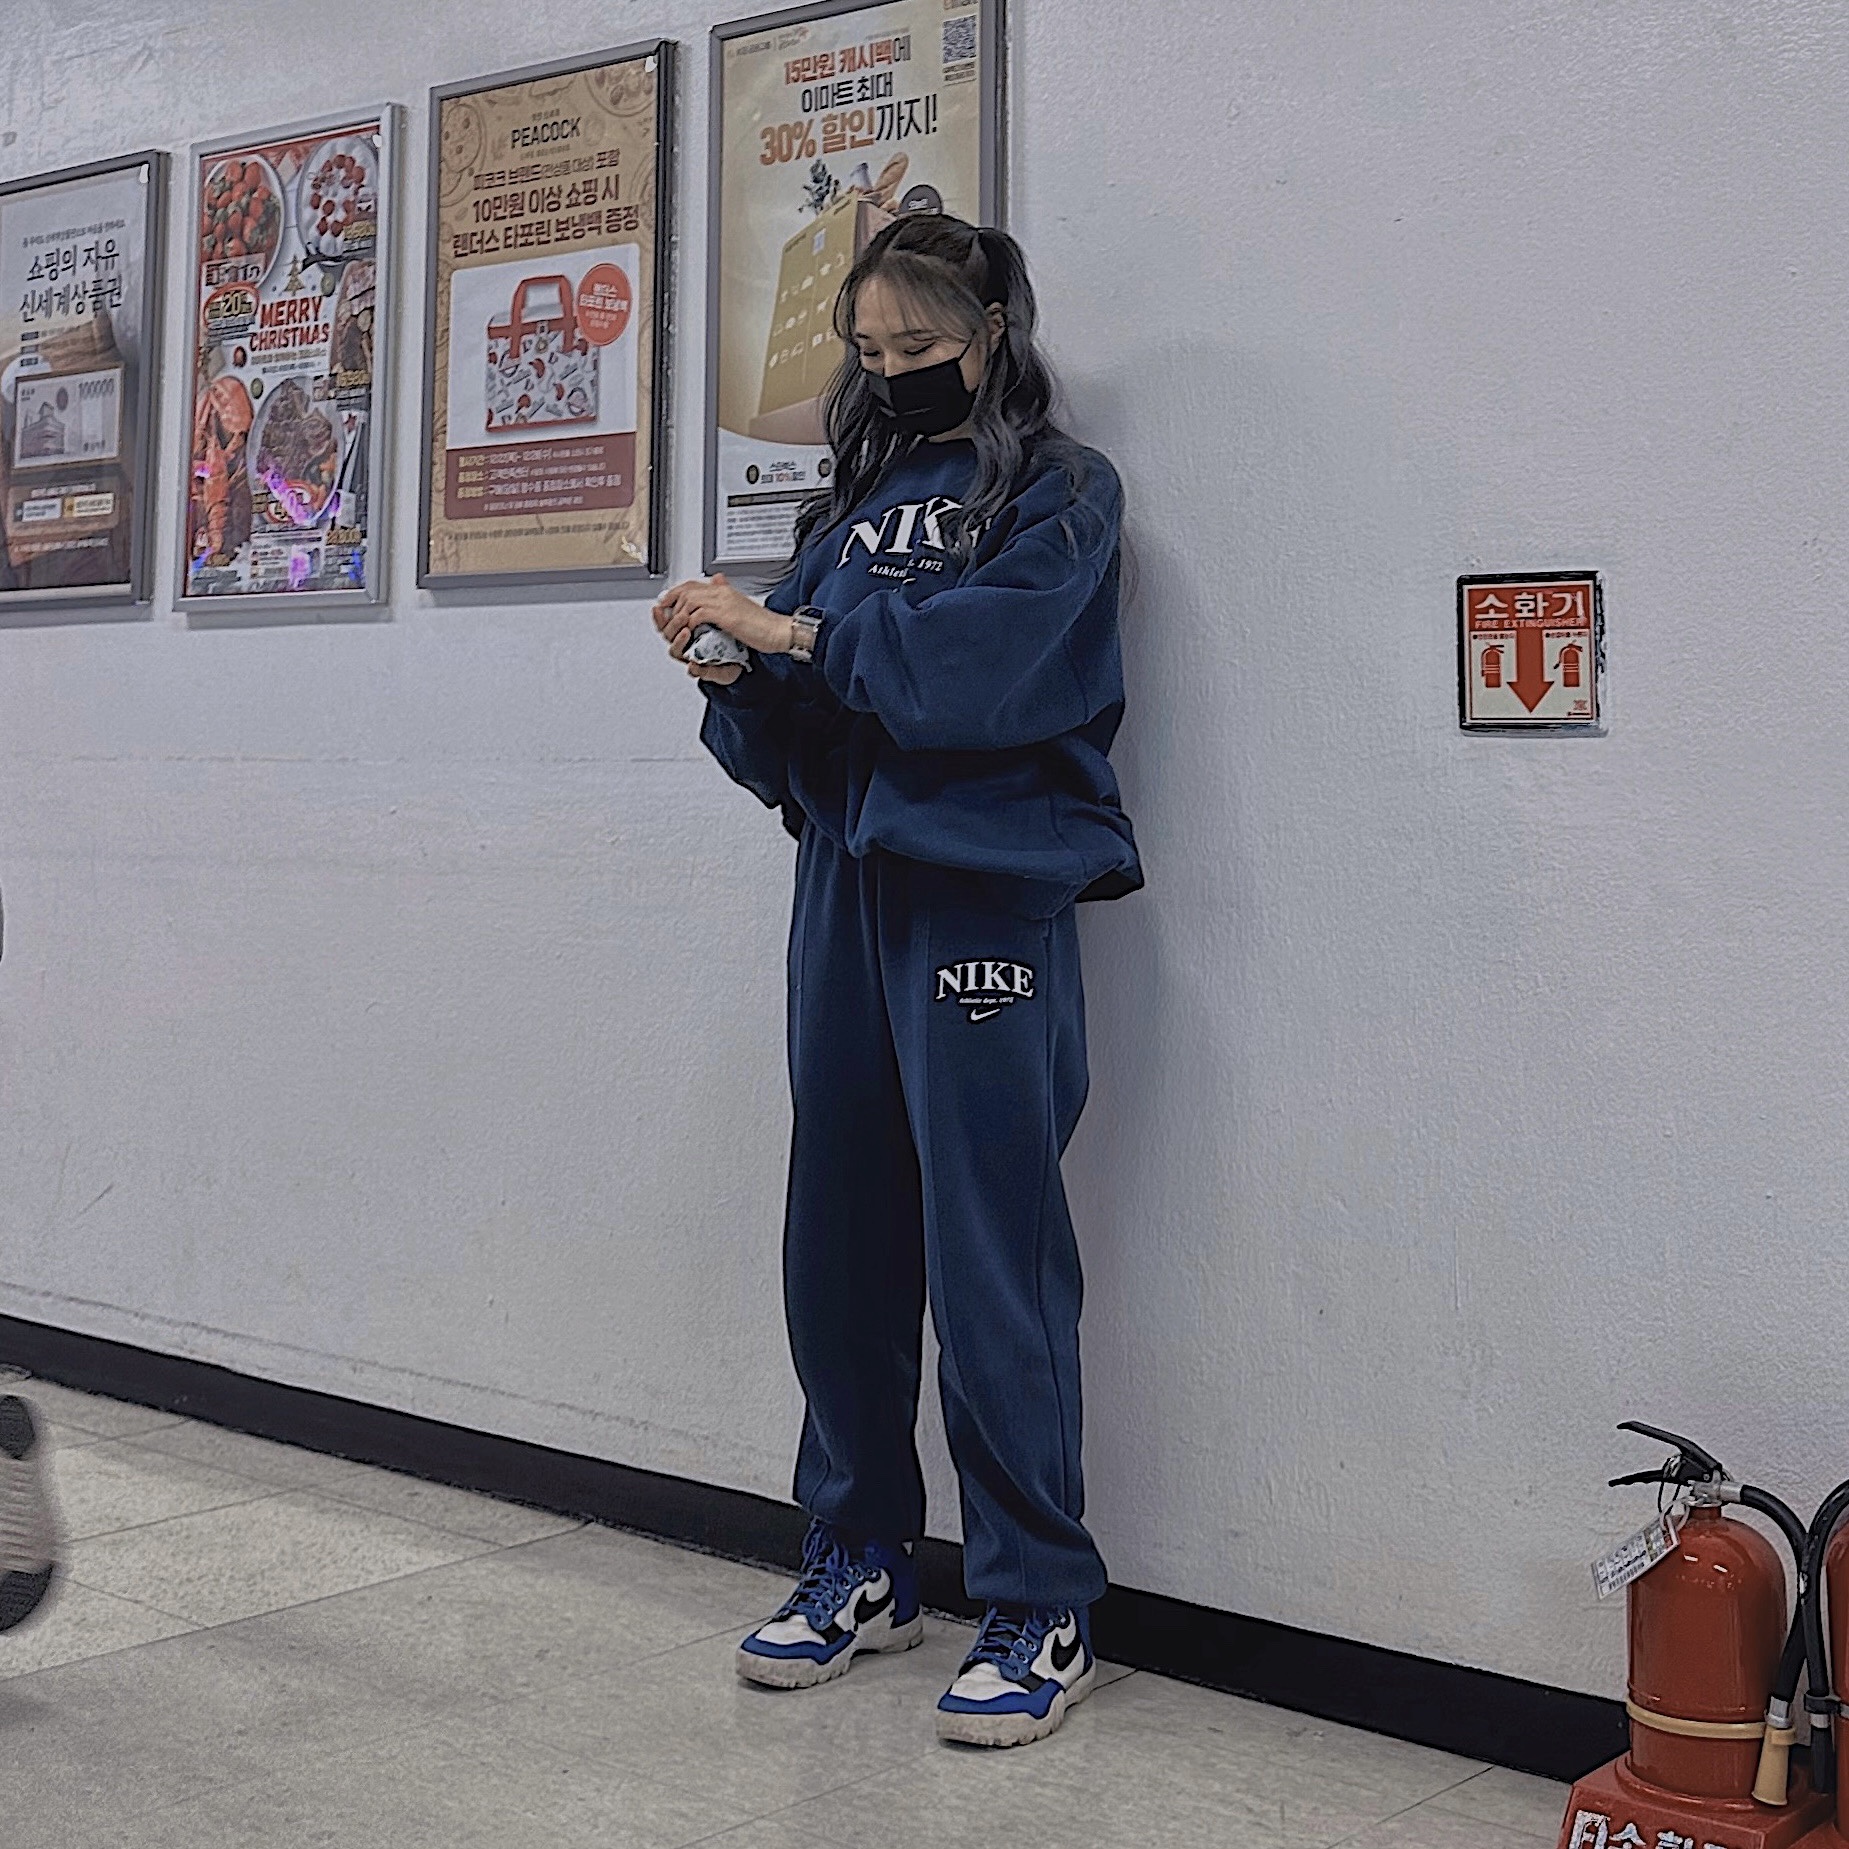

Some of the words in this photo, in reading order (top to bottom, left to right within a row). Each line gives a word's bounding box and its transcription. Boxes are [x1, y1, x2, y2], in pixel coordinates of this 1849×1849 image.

[784, 52, 835, 85] 15만원
[839, 34, 912, 75] 캐시백에
[801, 79, 854, 113] 이마트
[857, 71, 894, 103] 최대
[511, 117, 582, 149] PEACOCK
[759, 118, 817, 167] 30%
[821, 93, 938, 154] 할인까지!
[472, 190, 526, 224] 10만원
[528, 184, 561, 215] 이상
[564, 178, 600, 209] 쇼핑
[601, 174, 619, 201] 시
[453, 229, 500, 258] 랜더스
[503, 219, 551, 249] 타포린
[554, 210, 602, 242] 보냉백
[605, 205, 640, 233] 증정
[27, 243, 78, 281] 쇼핑의
[83, 238, 120, 272] 자유
[19, 273, 122, 323] 신세계상품권
[260, 295, 323, 329] MERRY
[249, 323, 329, 352] CHRISTMAS
[835, 496, 992, 570] NIK
[917, 558, 944, 572] 1972
[1474, 591, 1586, 619] 소화기
[1474, 619, 1499, 629] FIRE
[1503, 617, 1588, 629] EXTINGUISHER
[935, 961, 1034, 999] NIKE
